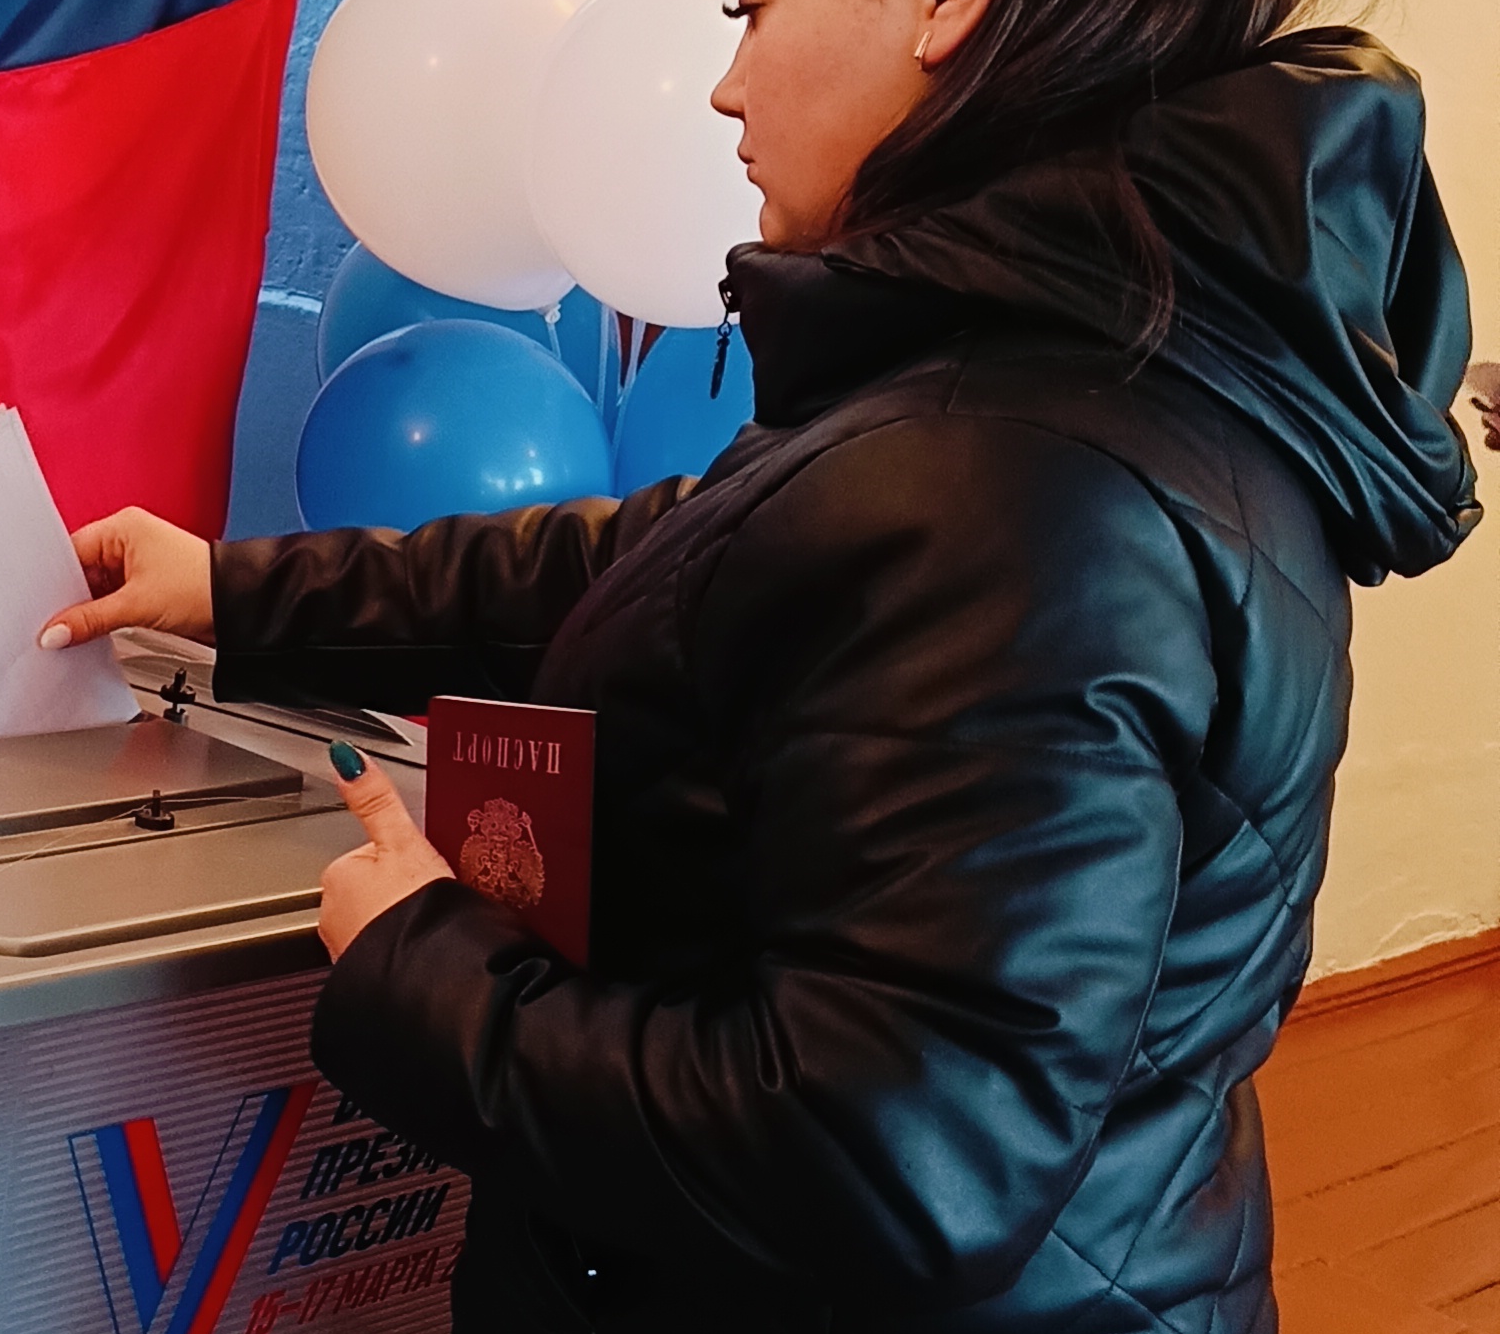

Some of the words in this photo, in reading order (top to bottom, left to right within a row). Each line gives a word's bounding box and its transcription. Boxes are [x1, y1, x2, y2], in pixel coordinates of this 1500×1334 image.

[453, 731, 561, 774] ПАСПОРТ
[267, 1182, 450, 1276] РОССИИ
[333, 1246, 441, 1314] МАРТА
